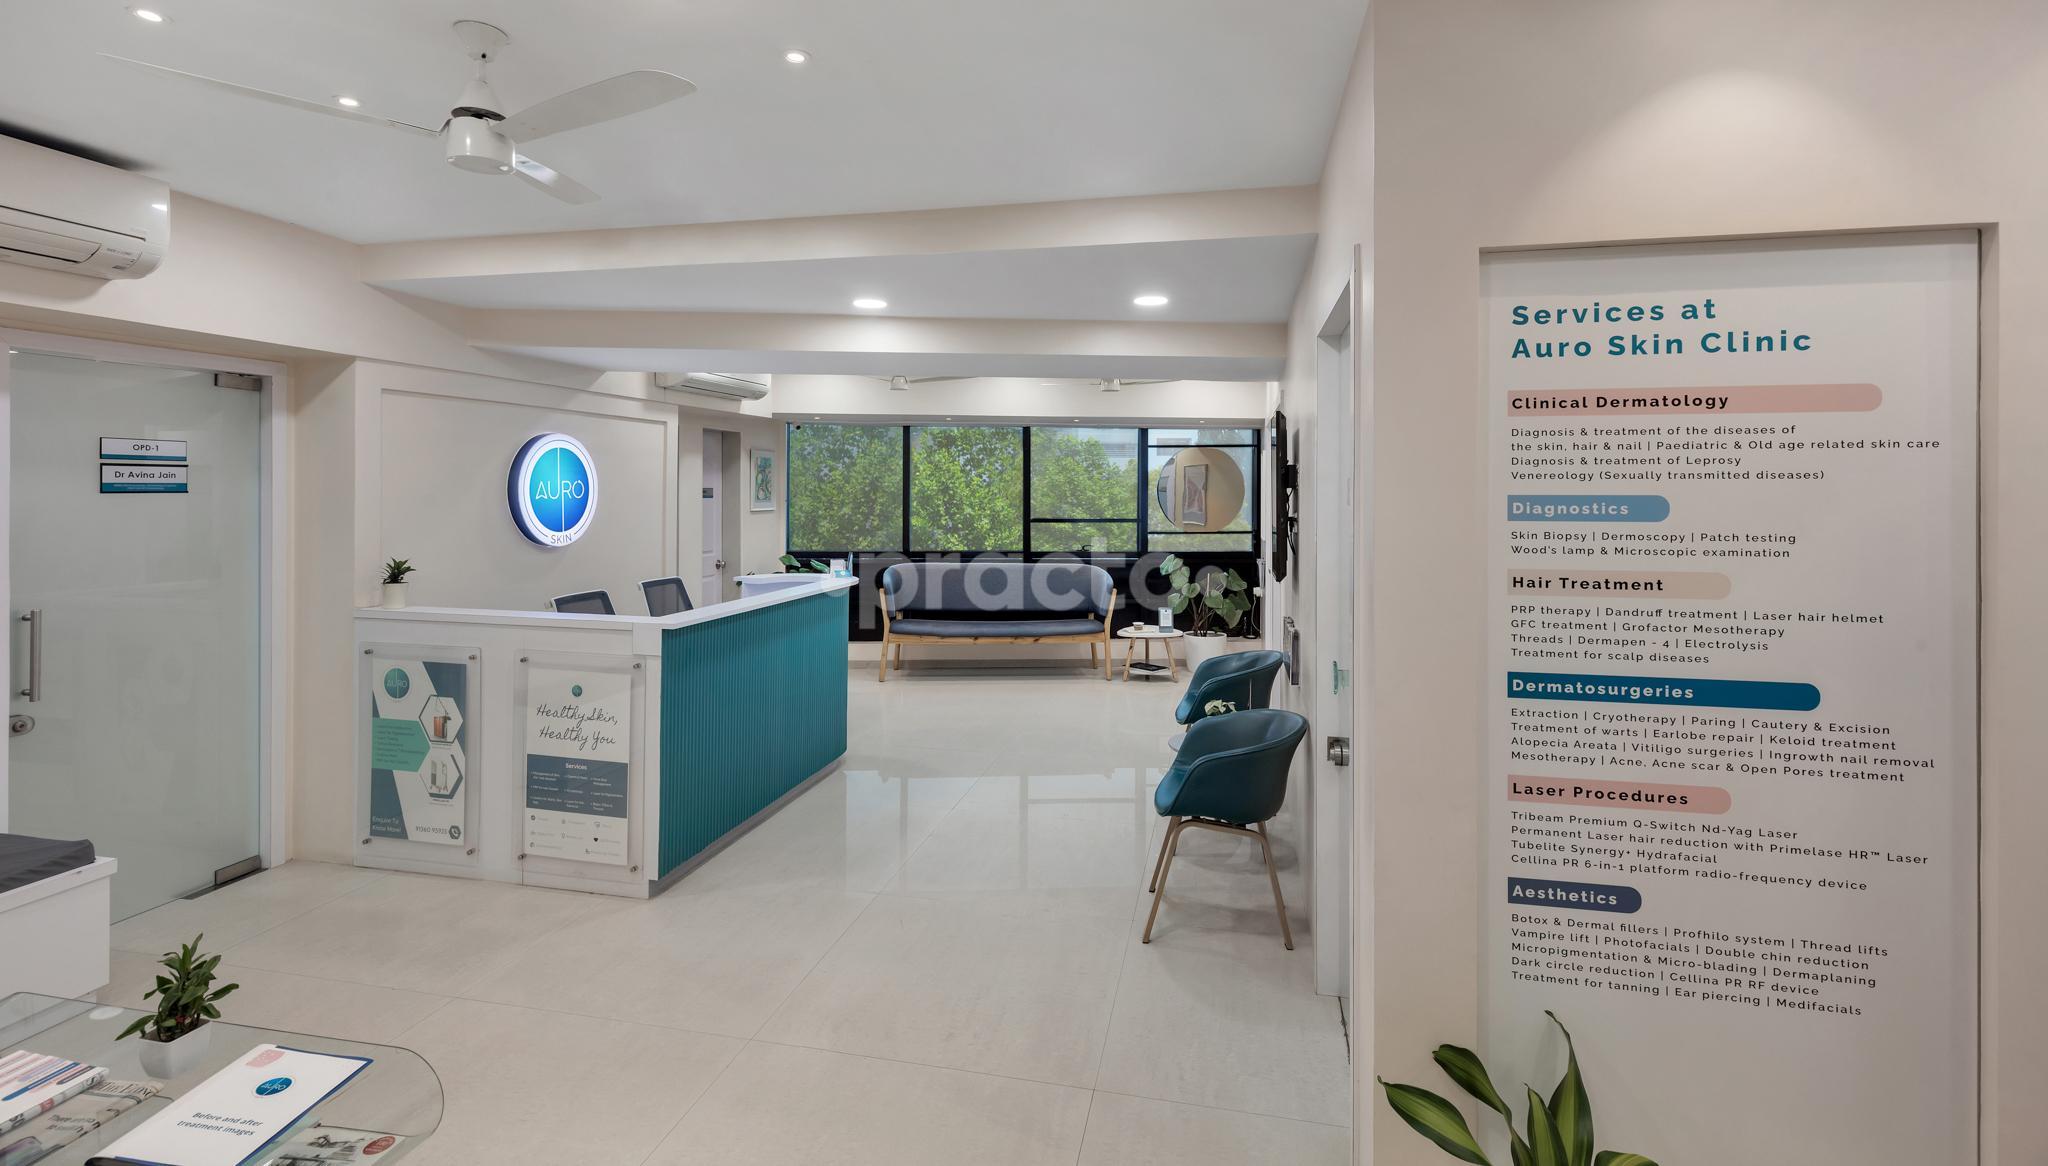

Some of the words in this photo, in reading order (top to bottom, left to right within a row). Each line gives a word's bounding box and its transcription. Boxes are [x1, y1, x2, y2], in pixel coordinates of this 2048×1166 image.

[1511, 301, 1664, 325] Services
[1680, 298, 1716, 320] at
[1511, 338, 1592, 359] Auro
[1607, 333, 1682, 356] Skin
[1700, 329, 1810, 353] Clinic
[1512, 396, 1588, 409] Clinical
[1596, 394, 1728, 409] Dermatology
[1511, 427, 1574, 439] Diagnosis
[1580, 427, 1588, 436] &
[1594, 426, 1661, 436] treatment
[1667, 426, 1680, 435] of
[1686, 426, 1708, 435] the
[1713, 425, 1776, 435] diseases
[1781, 424, 1796, 434] of
[132, 444, 159, 452] OPD-1
[1511, 442, 1532, 451] the
[1537, 442, 1567, 451] skin,
[1572, 441, 1598, 451] hair
[1603, 441, 1611, 450] &
[1617, 441, 1642, 450] nail
[1656, 440, 1727, 450] Paediatric
[1733, 440, 1742, 449] &
[1748, 440, 1772, 449] Old
[1778, 442, 1804, 451] age
[1810, 439, 1864, 449] related
[1871, 439, 1900, 448] skin
[1906, 440, 1940, 448] care
[128, 471, 155, 479] Avina
[158, 471, 177, 479] Jain
[1510, 471, 1594, 482] Venereology
[1599, 470, 1662, 482] (Sexually
[1667, 470, 1750, 480] transmitted
[1756, 470, 1824, 480] diseases)
[535, 479, 585, 500] AURO
[1512, 502, 1629, 518] Diagnostics
[550, 533, 573, 544] SKIN
[1511, 531, 1538, 540] Skin
[1543, 531, 1587, 543] Biopsy
[1601, 532, 1685, 544] Dermoscopy
[1700, 532, 1739, 542] Patch
[1745, 533, 1796, 545] testing
[1510, 545, 1557, 554] Wood's
[1562, 545, 1594, 557] lamp
[1600, 546, 1608, 555] &
[1614, 546, 1696, 558] Microscopic
[1702, 548, 1790, 558] examination
[1512, 576, 1551, 588] Hair
[1558, 577, 1663, 591] Treatment
[1511, 605, 1535, 614] PRP
[1540, 605, 1591, 618] therapy
[1605, 607, 1663, 617] Dandruff
[1668, 609, 1737, 619] treatment
[1753, 611, 1792, 621] Laser
[1798, 612, 1826, 622] hair
[1832, 612, 1884, 624] helmet
[1510, 619, 1536, 628] GFC
[1541, 620, 1607, 630] treatment
[1622, 622, 1688, 633] Grofactor
[1693, 624, 1784, 638] Mesotherapy
[1510, 633, 1563, 644] Threads
[1578, 635, 1646, 648] Dermapen
[1662, 640, 1669, 648] 4
[1684, 639, 1768, 652] Electrolysis
[1510, 647, 1578, 659] Treatment
[1583, 650, 1602, 659] for
[1607, 652, 1644, 663] scalp
[1648, 652, 1709, 663] diseases
[386, 680, 408, 688] AURO
[1512, 679, 1694, 700] Dermatosurgeries
[536, 703, 586, 729] Healthy
[1511, 707, 1578, 719] Extraction
[1592, 711, 1676, 726] Cryotherapy
[1691, 716, 1736, 729] Paring
[1751, 719, 1808, 733] Cautery
[1813, 722, 1822, 731] &
[1829, 722, 1890, 735] Excision
[539, 726, 588, 751] Healthy
[590, 730, 617, 750] You
[1511, 736, 1568, 748] Alopecia
[1573, 740, 1617, 750] Areata
[1631, 743, 1682, 756] Vitiligo
[1687, 747, 1754, 758] surgeries
[1769, 750, 1834, 762] Ingrowth
[1840, 754, 1867, 764] nail
[1873, 758, 1934, 768] removal
[565, 762, 588, 770] Services
[1512, 782, 1565, 797] Laser
[1573, 786, 1688, 805] Procedures
[1511, 810, 1564, 822] Tribeam
[1569, 815, 1627, 827] Premium
[1633, 819, 1696, 832] Q-Switch
[1702, 824, 1752, 838] Nd-Yag
[1758, 828, 1798, 839] Laser
[1511, 839, 1565, 852] Tubelite
[1636, 849, 1717, 864] Hydrafacial
[1511, 854, 1557, 866] Cellina
[1562, 857, 1578, 867] PR
[1584, 859, 1624, 871] 6-in-1
[1630, 863, 1689, 876] platform
[1695, 869, 1812, 888] radio-frequency
[1818, 878, 1867, 890] device
[1512, 884, 1618, 906] Aesthetics
[1511, 913, 1548, 925] Botox
[1553, 917, 1561, 926] &
[1567, 918, 1614, 931] Dermal
[1620, 923, 1658, 935] fillers
[1673, 928, 1729, 941] Profhilo
[1735, 935, 1784, 947] system
[1800, 939, 1851, 953] Thread
[1858, 944, 1888, 957] lifts
[1511, 927, 1564, 941] Vampire
[1570, 932, 1589, 943] lift
[1604, 936, 1690, 953] Photofacials
[1705, 945, 1755, 959] Double
[1761, 951, 1791, 962] chin
[1797, 956, 1869, 970] reduction
[1511, 942, 1638, 962] Micropigmentation
[1643, 954, 1651, 964] &
[1658, 956, 1756, 977] Micro-blading
[1772, 967, 1876, 989] Dermaplaning
[1511, 956, 1540, 967] Dark
[1546, 960, 1584, 972] circle
[1589, 965, 1654, 979] reduction
[1669, 972, 1718, 985] Cellina
[1724, 977, 1742, 988] PR
[1748, 979, 1765, 989] RF
[1770, 982, 1819, 996] device
[1511, 970, 1578, 986] Treatment
[1584, 978, 1602, 988] for
[1608, 980, 1659, 996] tanning
[1674, 987, 1696, 998] Ear
[1702, 991, 1760, 1007] piercing
[1776, 997, 1861, 1016] Medifacials
[177, 1120, 224, 1132] treatment
[222, 1127, 255, 1136] images
[192, 1112, 222, 1120] Before
[222, 1116, 242, 1124] and
[240, 1119, 264, 1127] after
